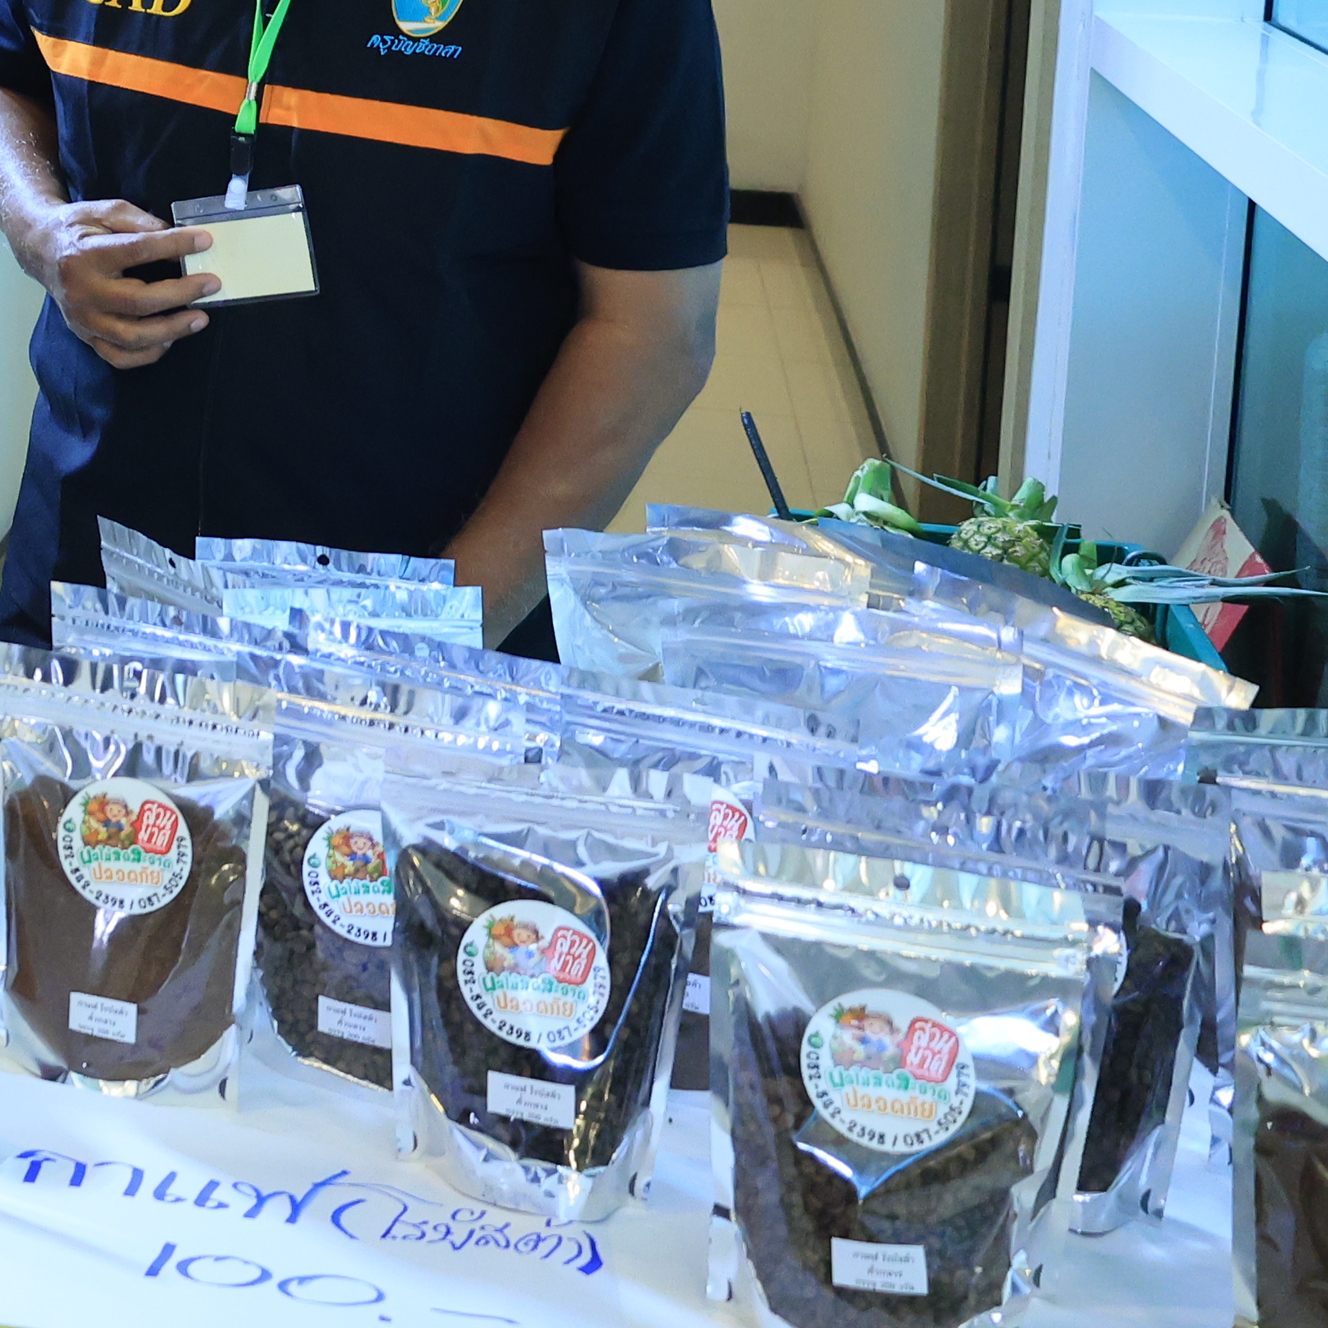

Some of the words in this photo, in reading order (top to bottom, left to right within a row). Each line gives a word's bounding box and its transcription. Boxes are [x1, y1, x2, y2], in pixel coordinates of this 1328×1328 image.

[142, 802, 176, 829] สวน
[92, 862, 162, 885] ปลอดภัย
[327, 878, 392, 899] ผลไม้สดส
[342, 897, 396, 916] ปลอด
[557, 929, 593, 958] สวน
[495, 990, 575, 1018] ปลอดภัย
[913, 1020, 957, 1054] สวน
[845, 1085, 935, 1120] ปลอดภัย
